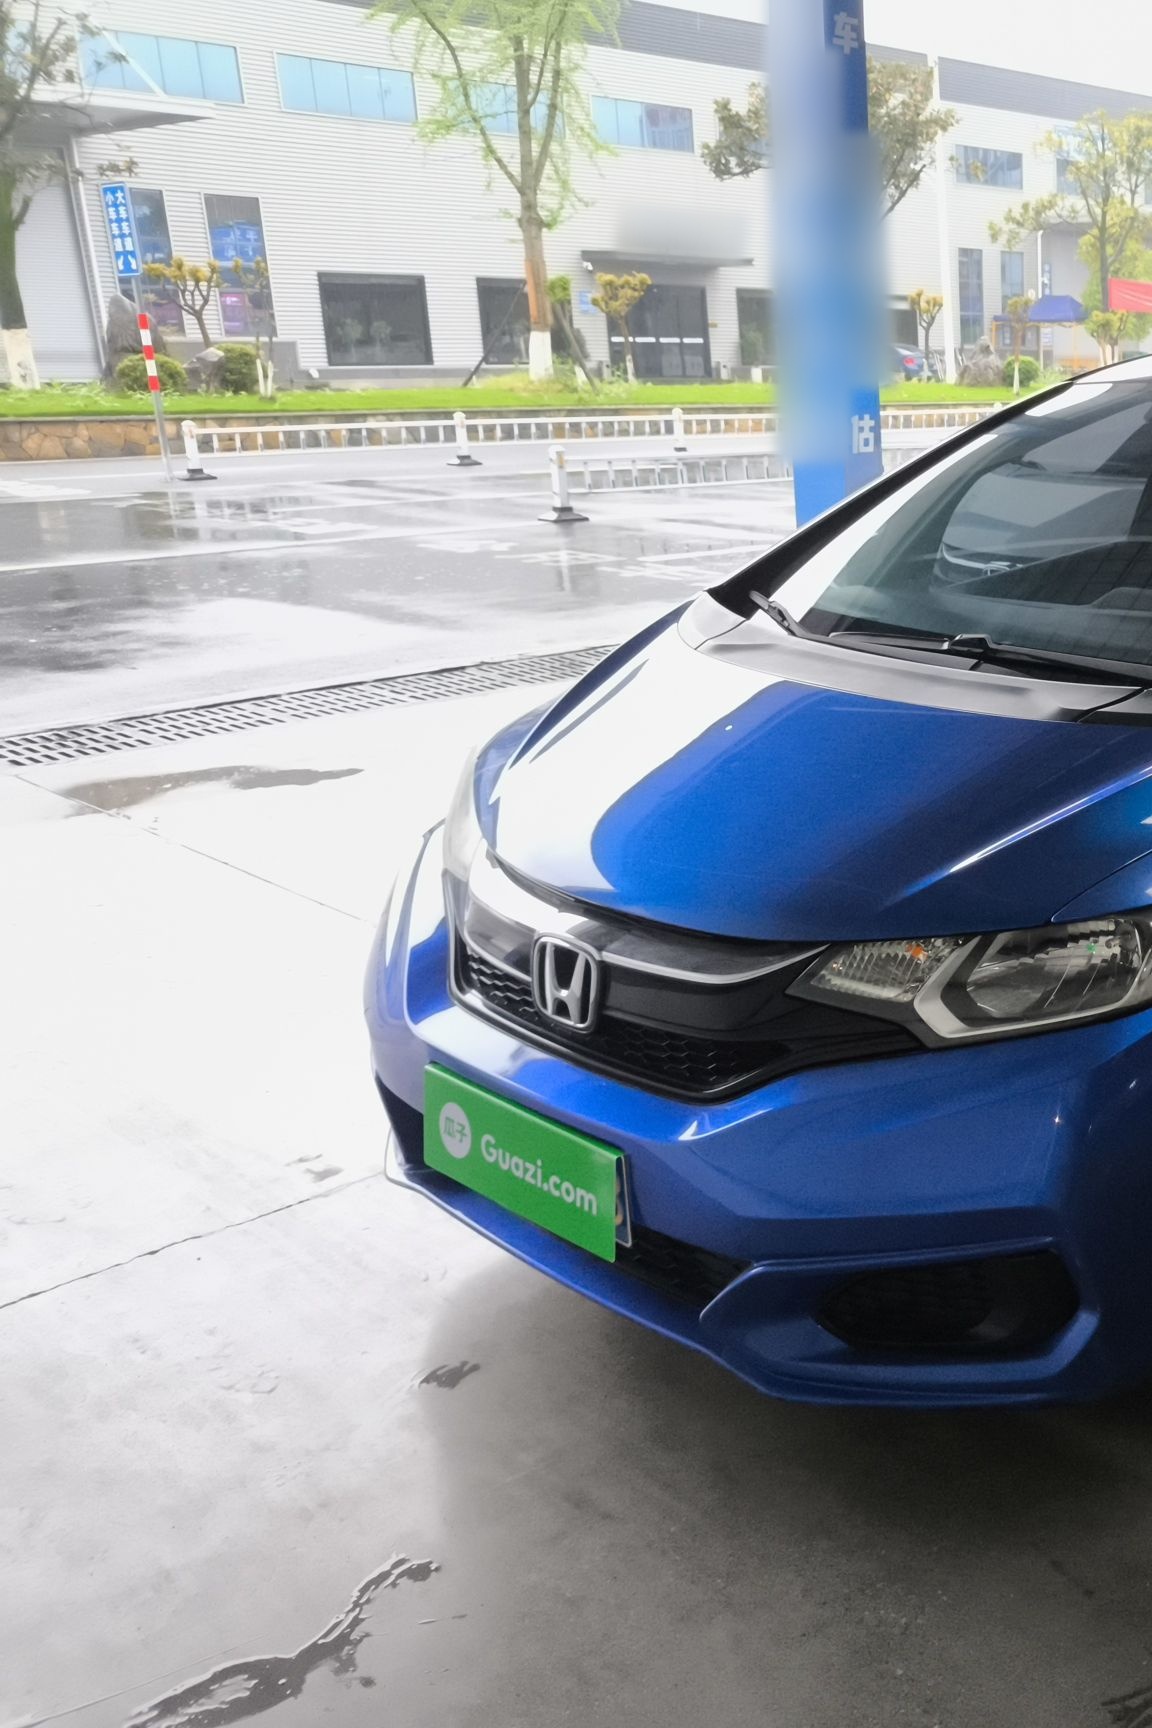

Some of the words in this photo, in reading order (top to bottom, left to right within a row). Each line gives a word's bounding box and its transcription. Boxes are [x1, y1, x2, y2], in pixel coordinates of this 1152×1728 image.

[833, 11, 859, 55] 车
[105, 191, 123, 252] 小车车道
[115, 190, 134, 252] 大车车道
[851, 414, 875, 454] 估
[443, 1116, 467, 1143] 瓜子
[480, 1134, 598, 1216] Guazi.com
